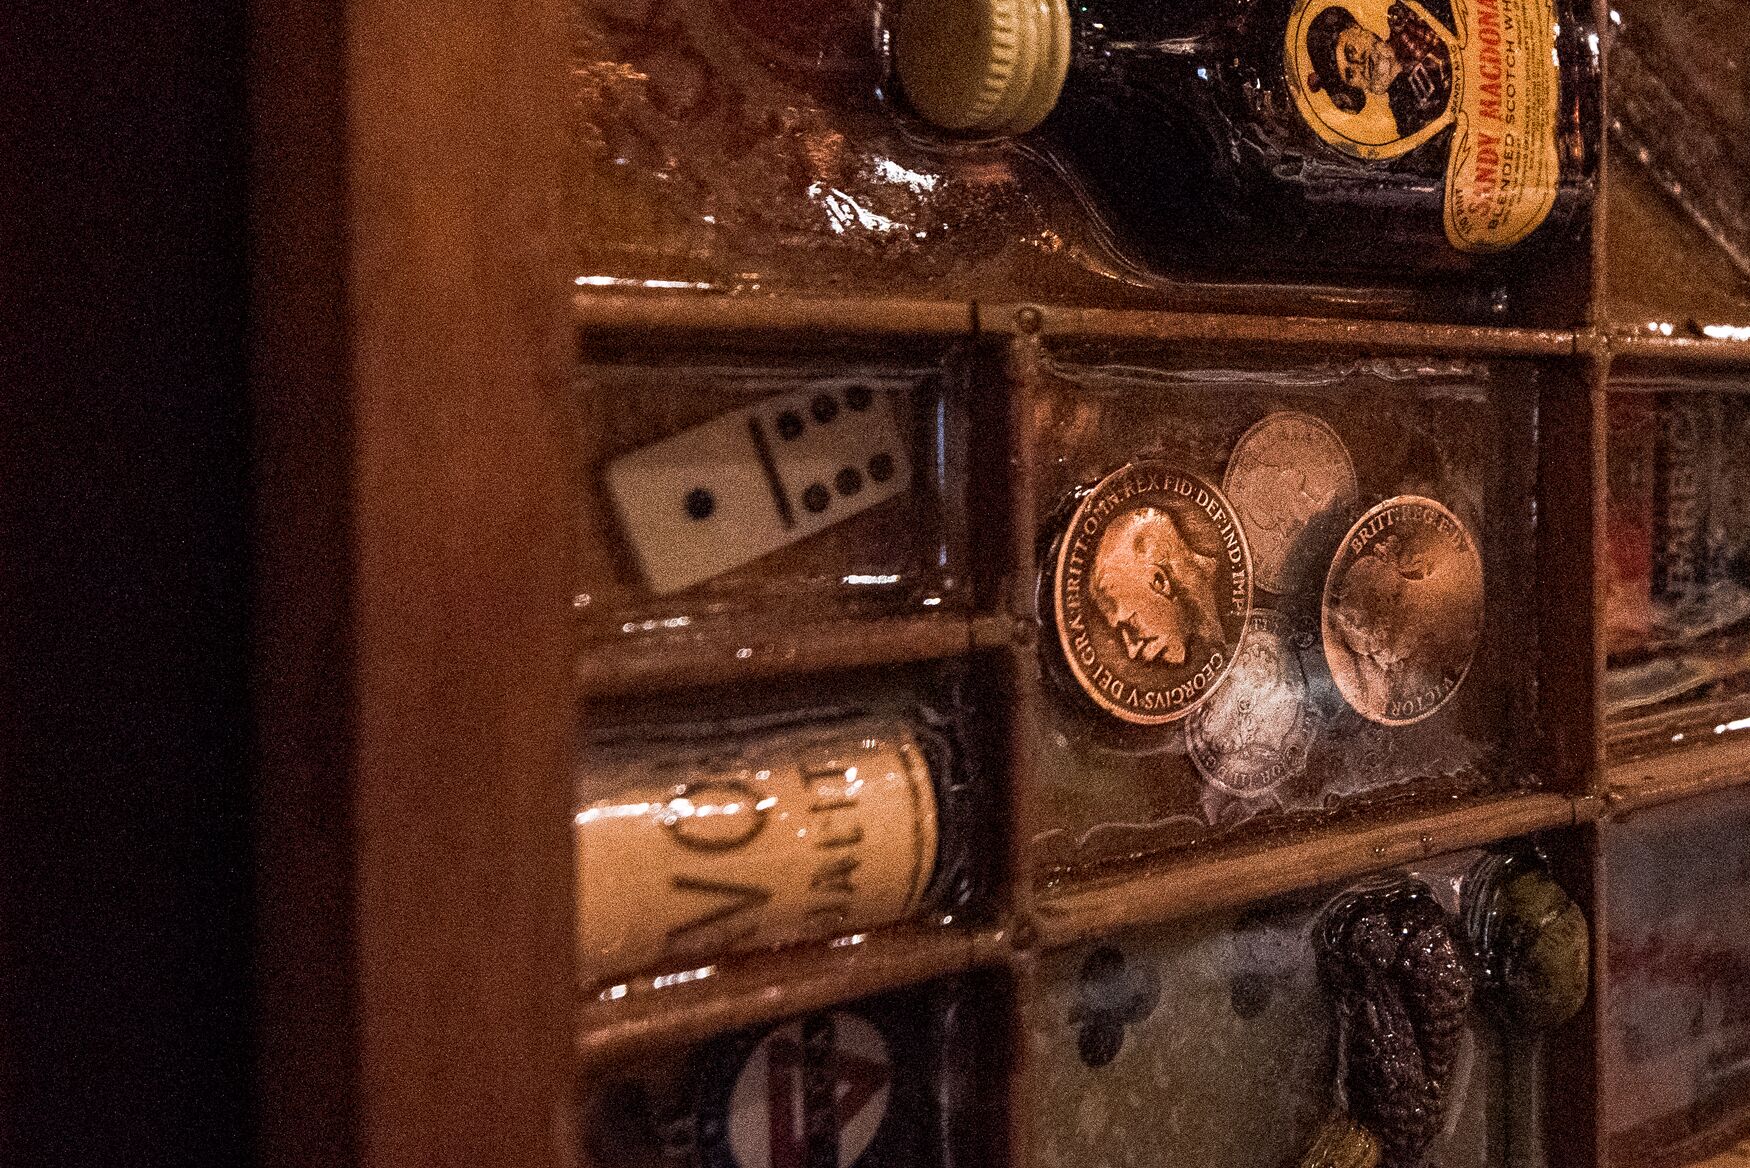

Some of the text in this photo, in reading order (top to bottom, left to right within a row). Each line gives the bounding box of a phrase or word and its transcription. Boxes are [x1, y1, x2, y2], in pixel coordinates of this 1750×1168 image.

[1468, 132, 1501, 218] SANDY
[1487, 133, 1515, 230] BLENDED
[1504, 40, 1516, 126] SCOTCH
[1091, 665, 1126, 699] DEI
